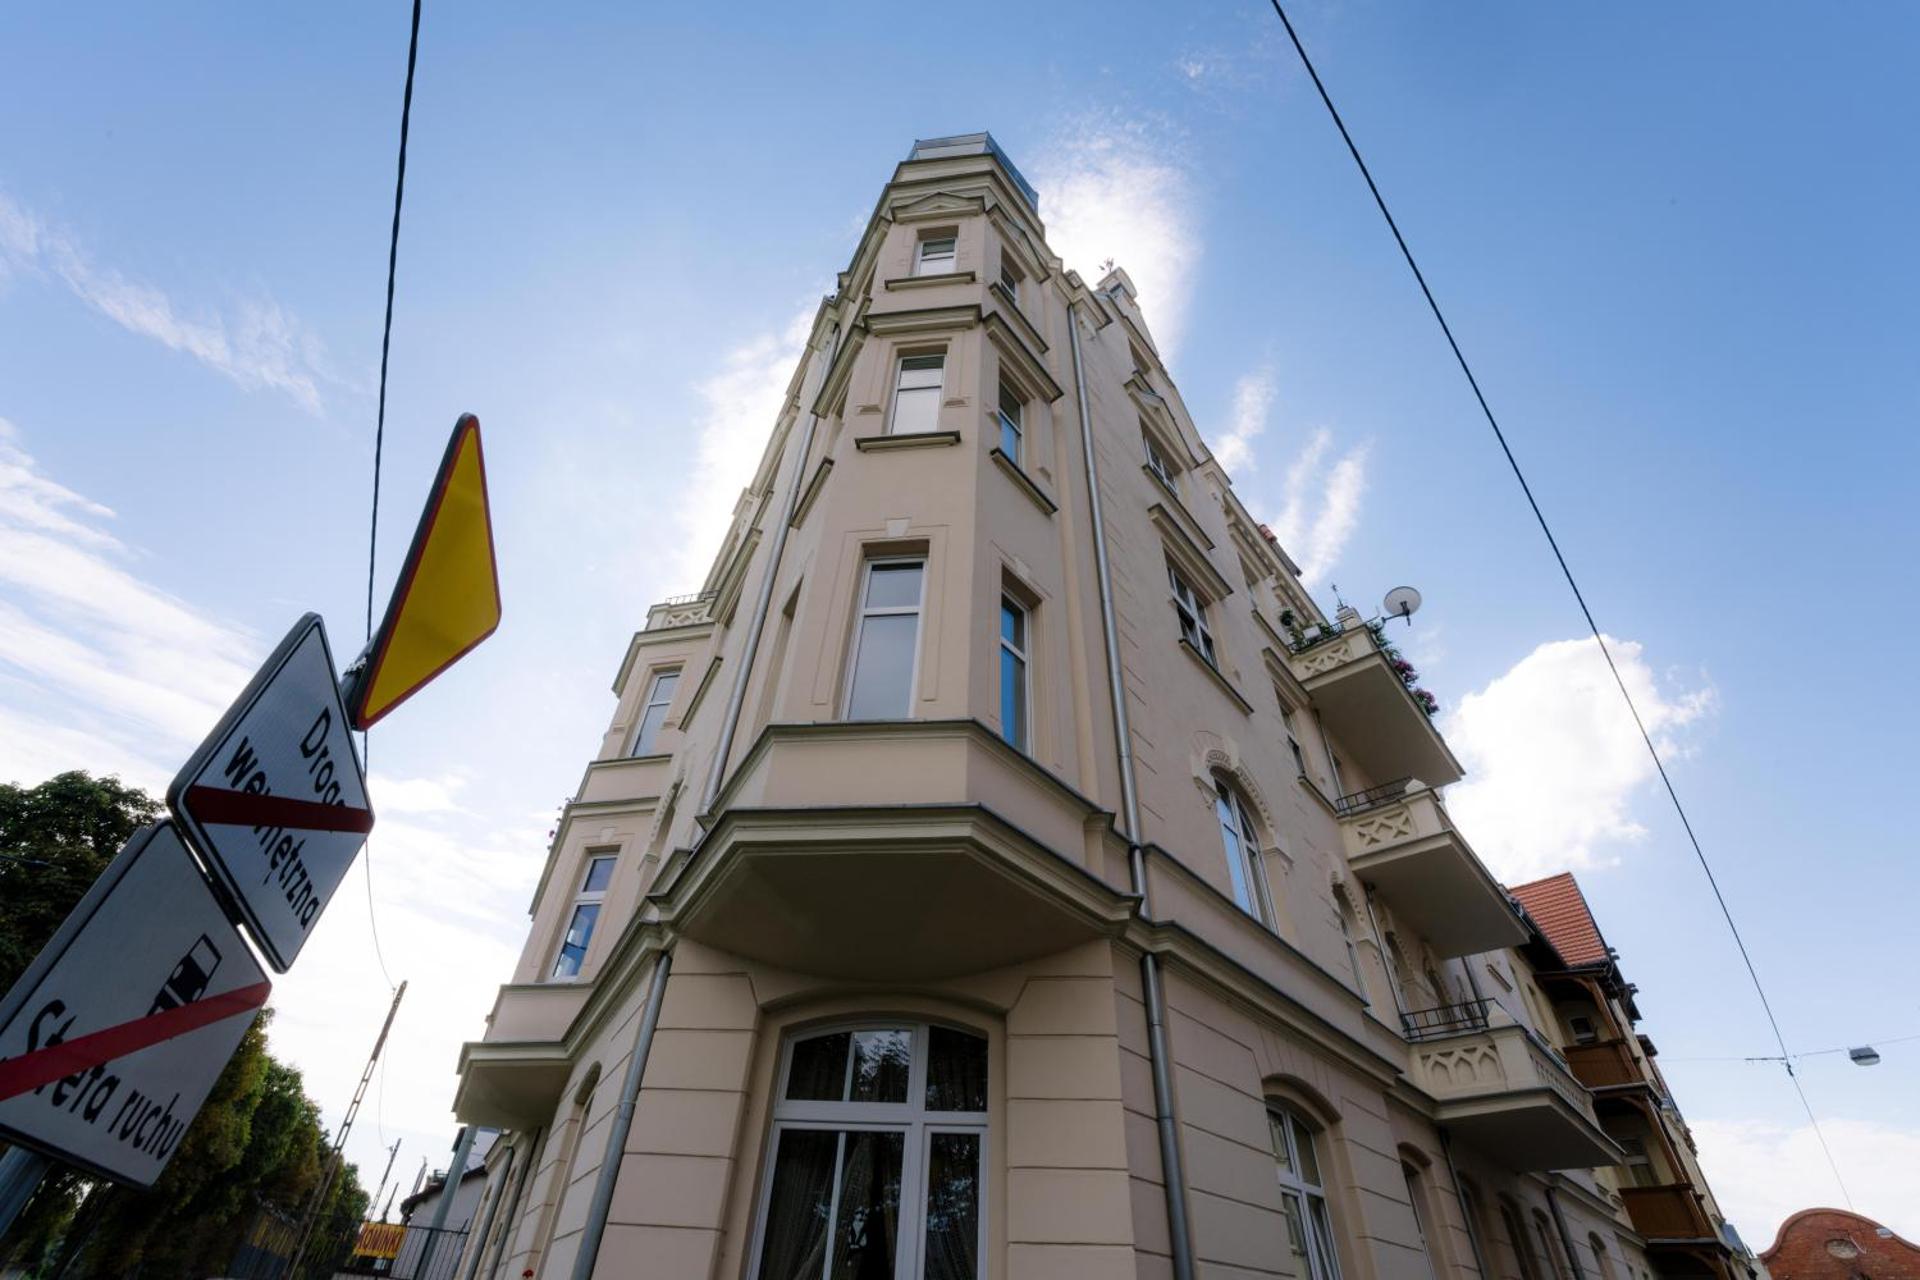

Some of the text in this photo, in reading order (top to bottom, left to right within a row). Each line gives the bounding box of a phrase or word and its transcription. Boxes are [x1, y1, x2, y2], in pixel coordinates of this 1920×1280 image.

[224, 735, 319, 930] wenętrzna
[299, 706, 346, 832] Dro
[0, 1000, 184, 1160] Sefa ruchu
